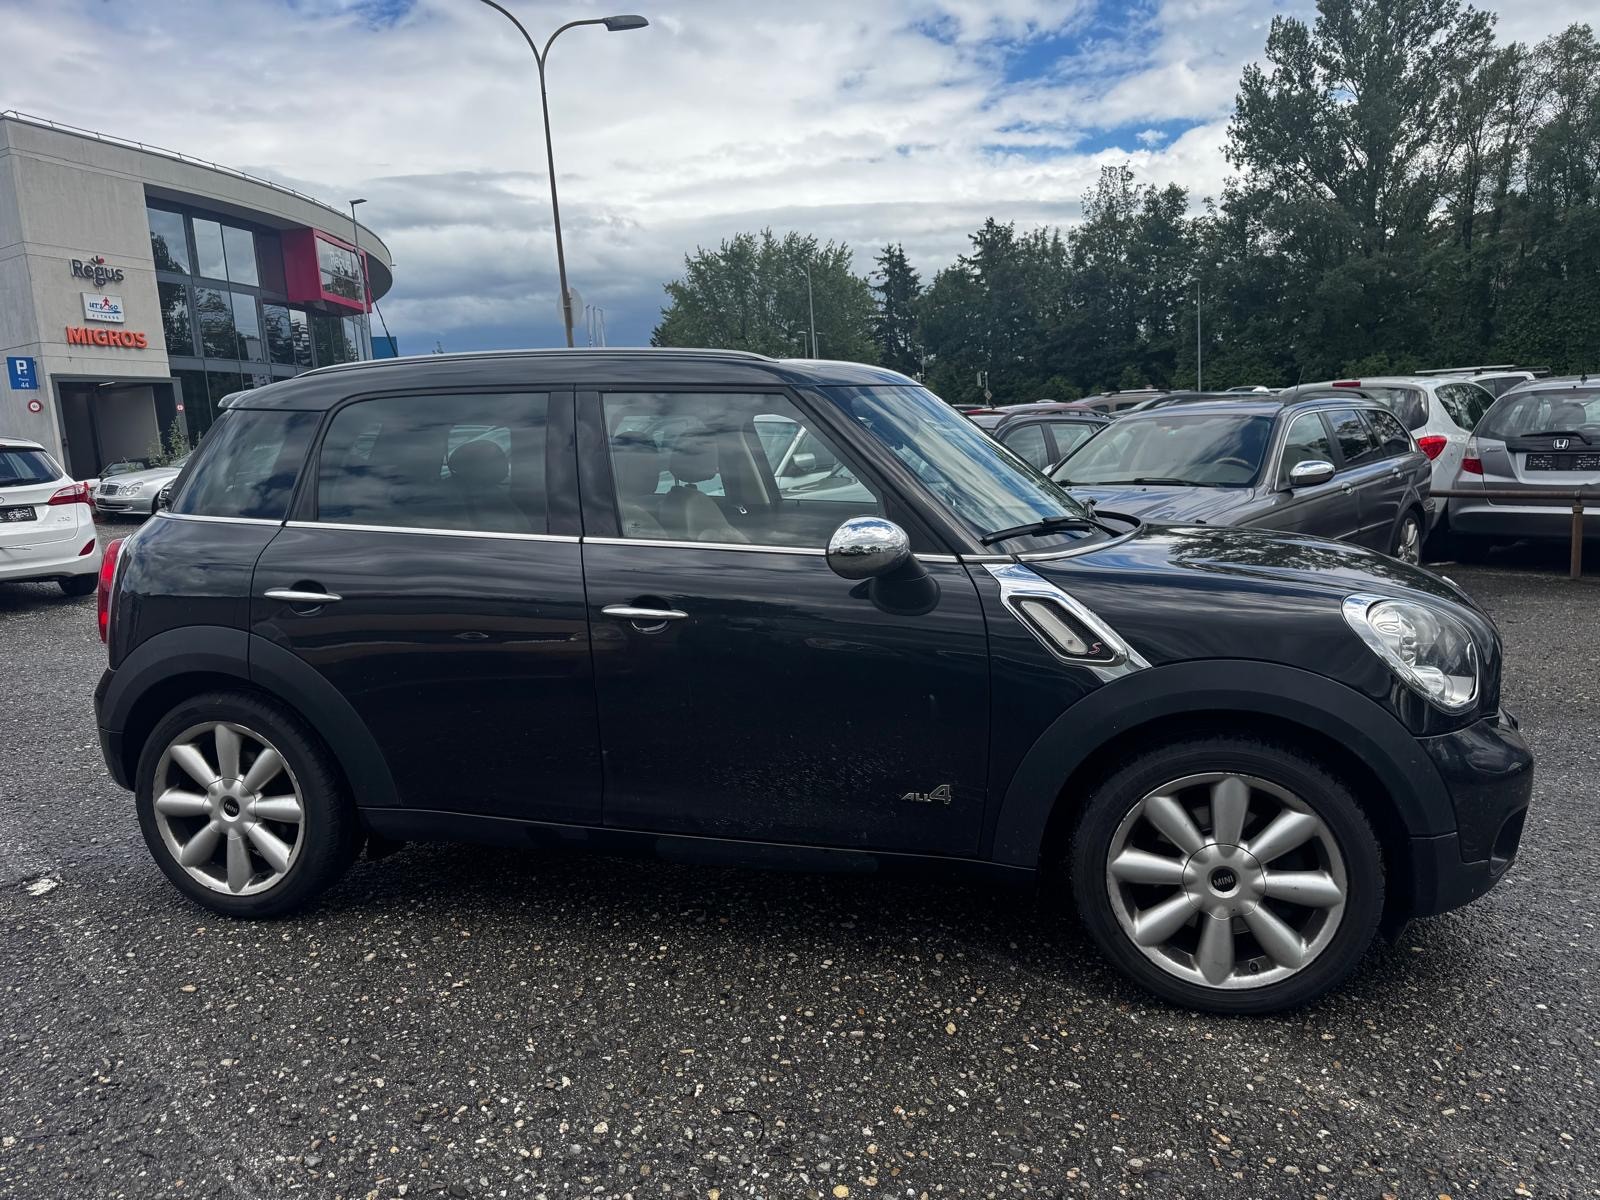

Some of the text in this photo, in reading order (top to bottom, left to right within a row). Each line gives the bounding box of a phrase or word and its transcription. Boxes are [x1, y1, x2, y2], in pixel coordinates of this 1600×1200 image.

[71, 259, 124, 287] Regus
[329, 251, 351, 276] Regus
[66, 326, 147, 349] MIGROS
[15, 360, 28, 375] P
[1088, 642, 1102, 655] S
[1213, 874, 1234, 886] MINI
